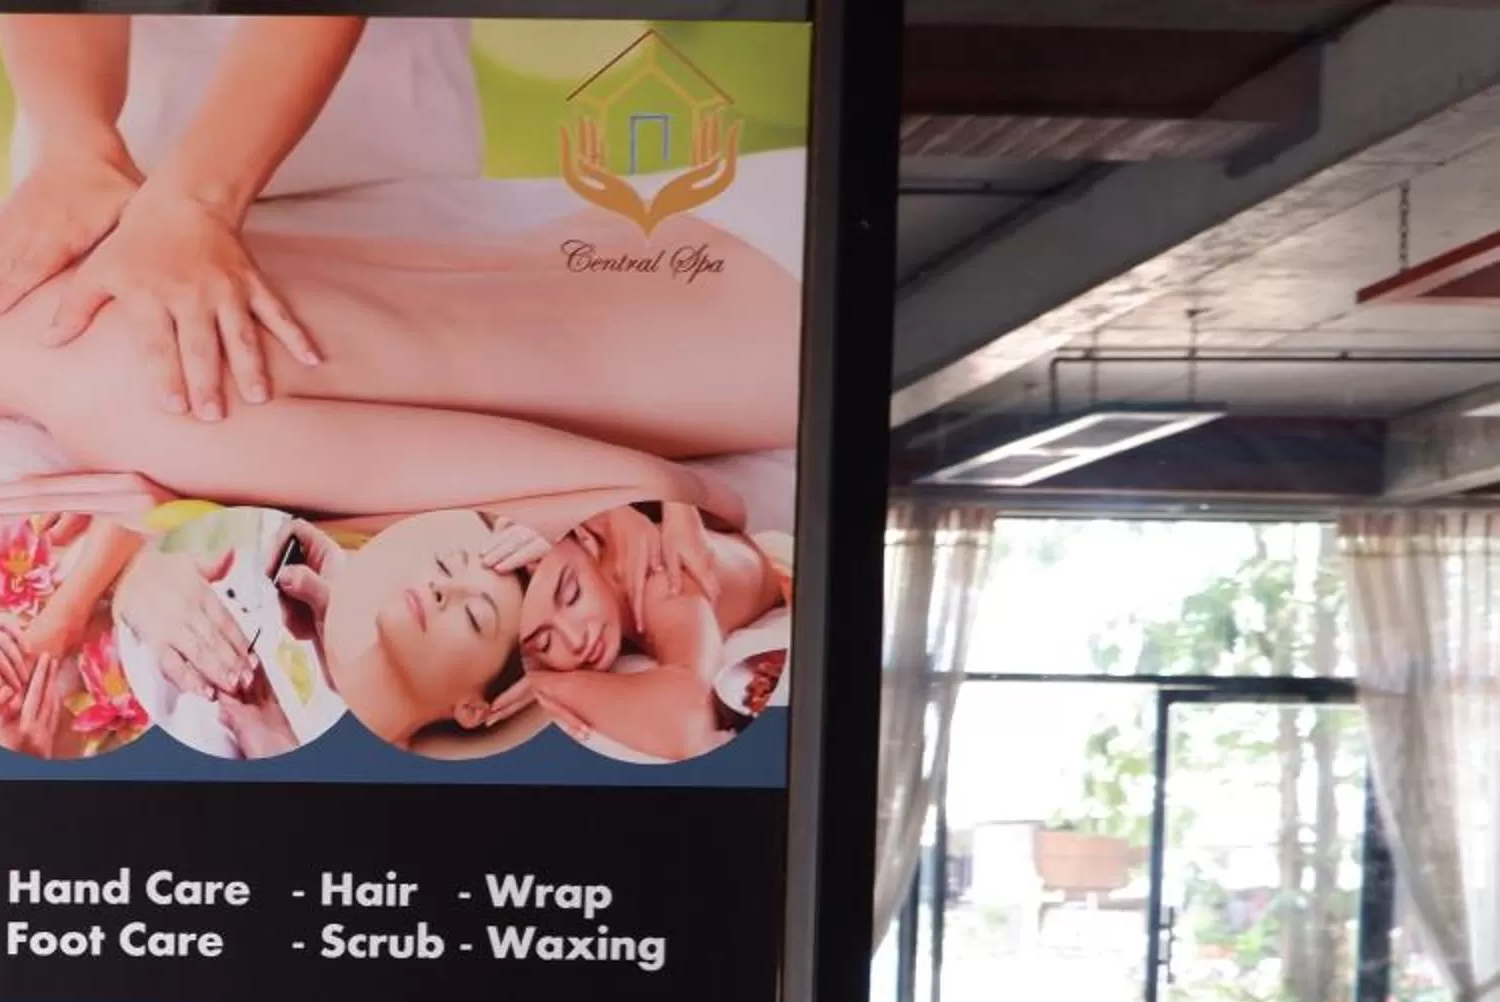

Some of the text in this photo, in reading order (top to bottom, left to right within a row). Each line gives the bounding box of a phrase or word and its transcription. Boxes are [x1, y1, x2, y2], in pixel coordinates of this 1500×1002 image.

[560, 239, 725, 285] Central Spa
[8, 867, 251, 906] Hand Care
[321, 870, 419, 907] Hair
[485, 873, 613, 919] Wrap
[7, 921, 224, 957] Foot Care
[320, 921, 445, 959] Scrub
[486, 924, 667, 972] Waxing
